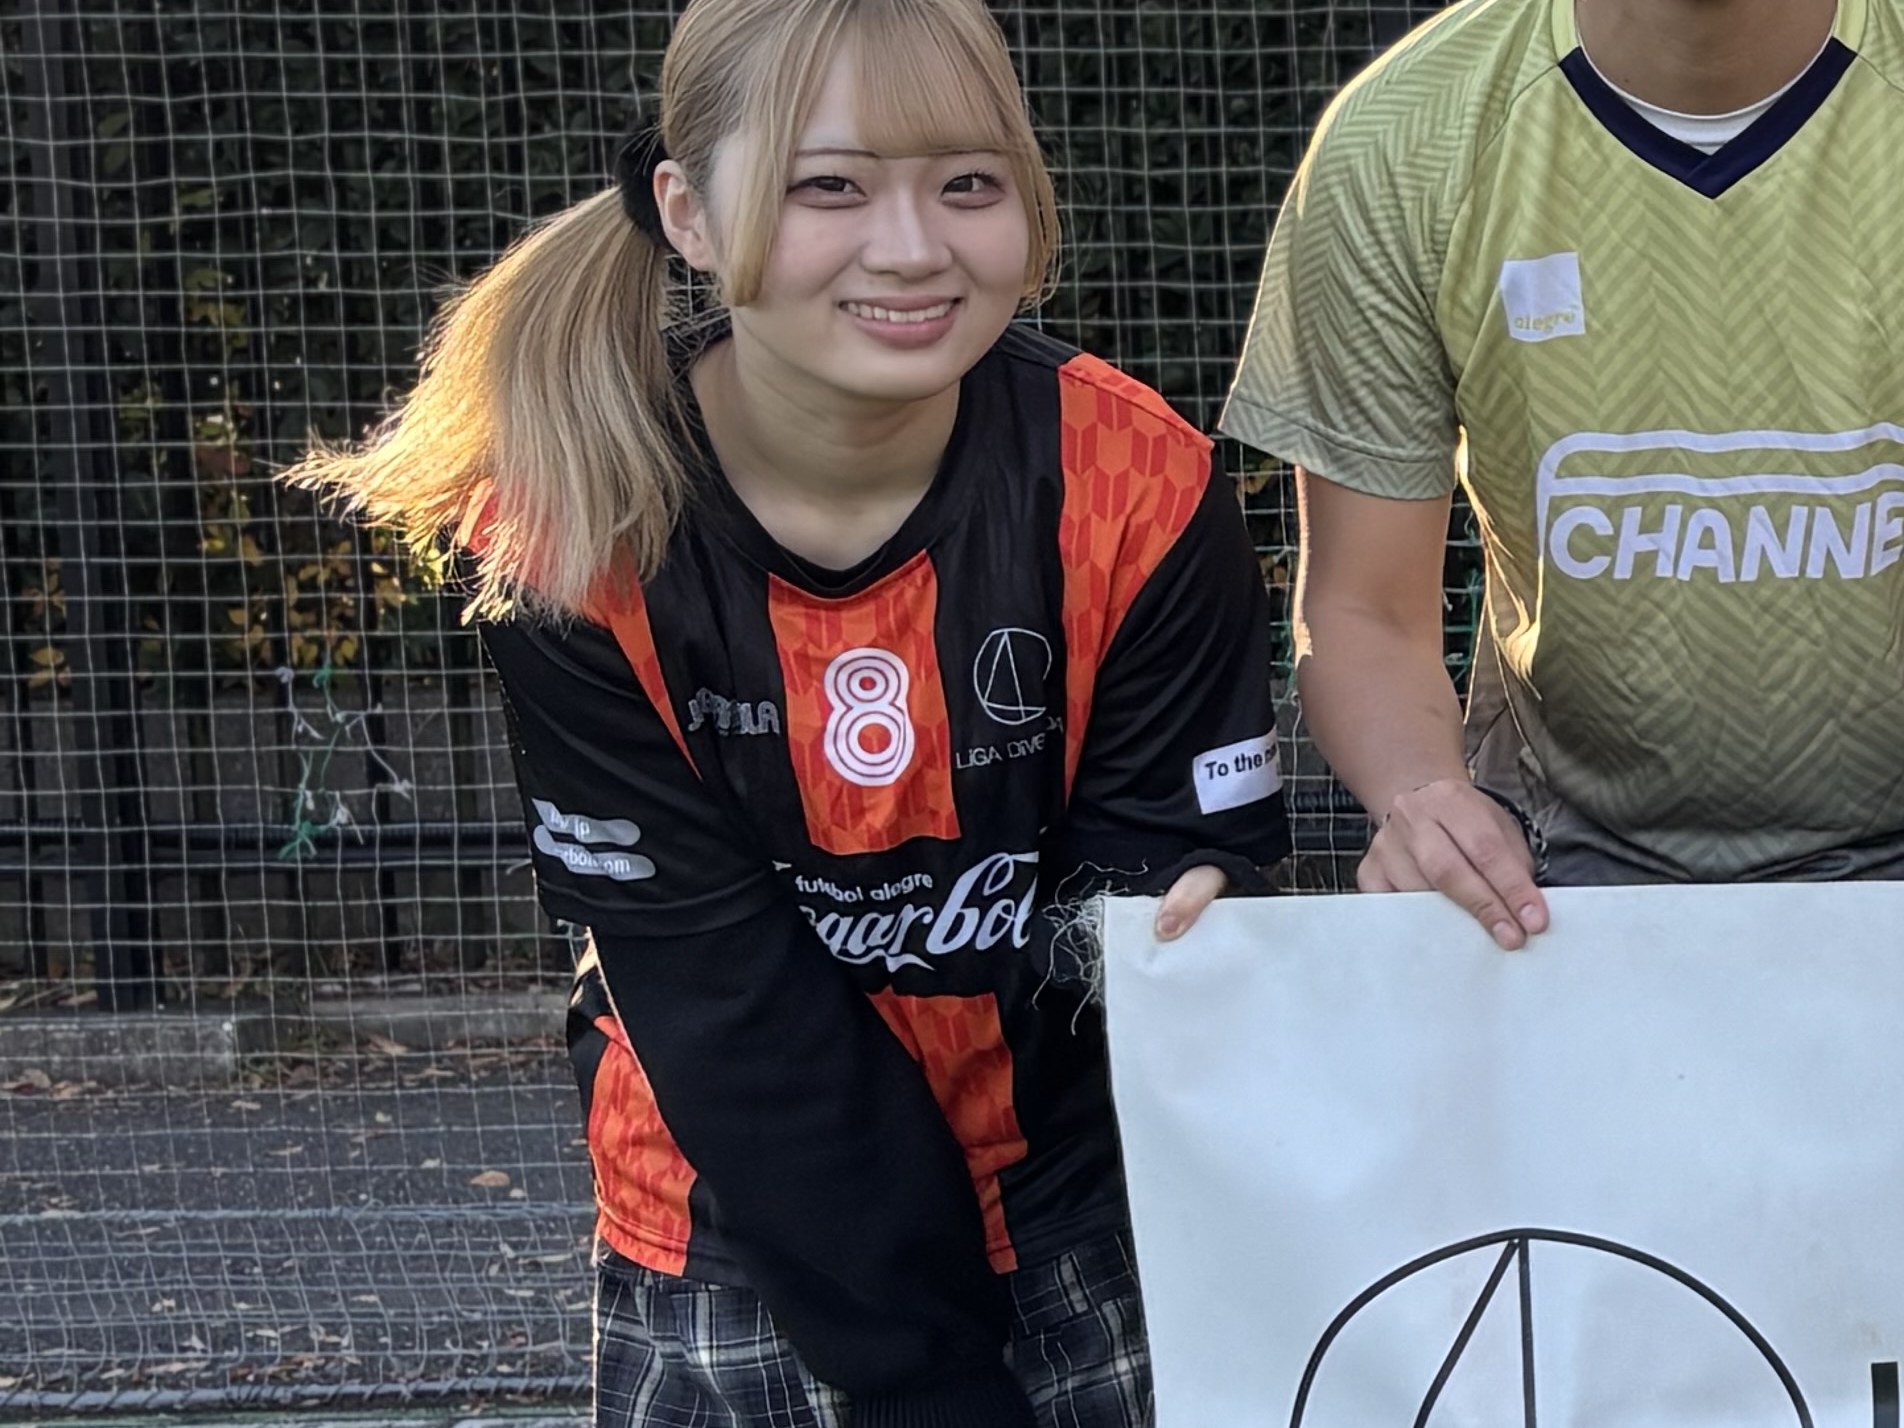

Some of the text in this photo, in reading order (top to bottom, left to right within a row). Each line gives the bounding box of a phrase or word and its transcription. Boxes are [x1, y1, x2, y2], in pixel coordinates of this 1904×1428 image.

[823, 646, 916, 787] 8
[1204, 760, 1229, 780] To
[1234, 753, 1263, 773] the
